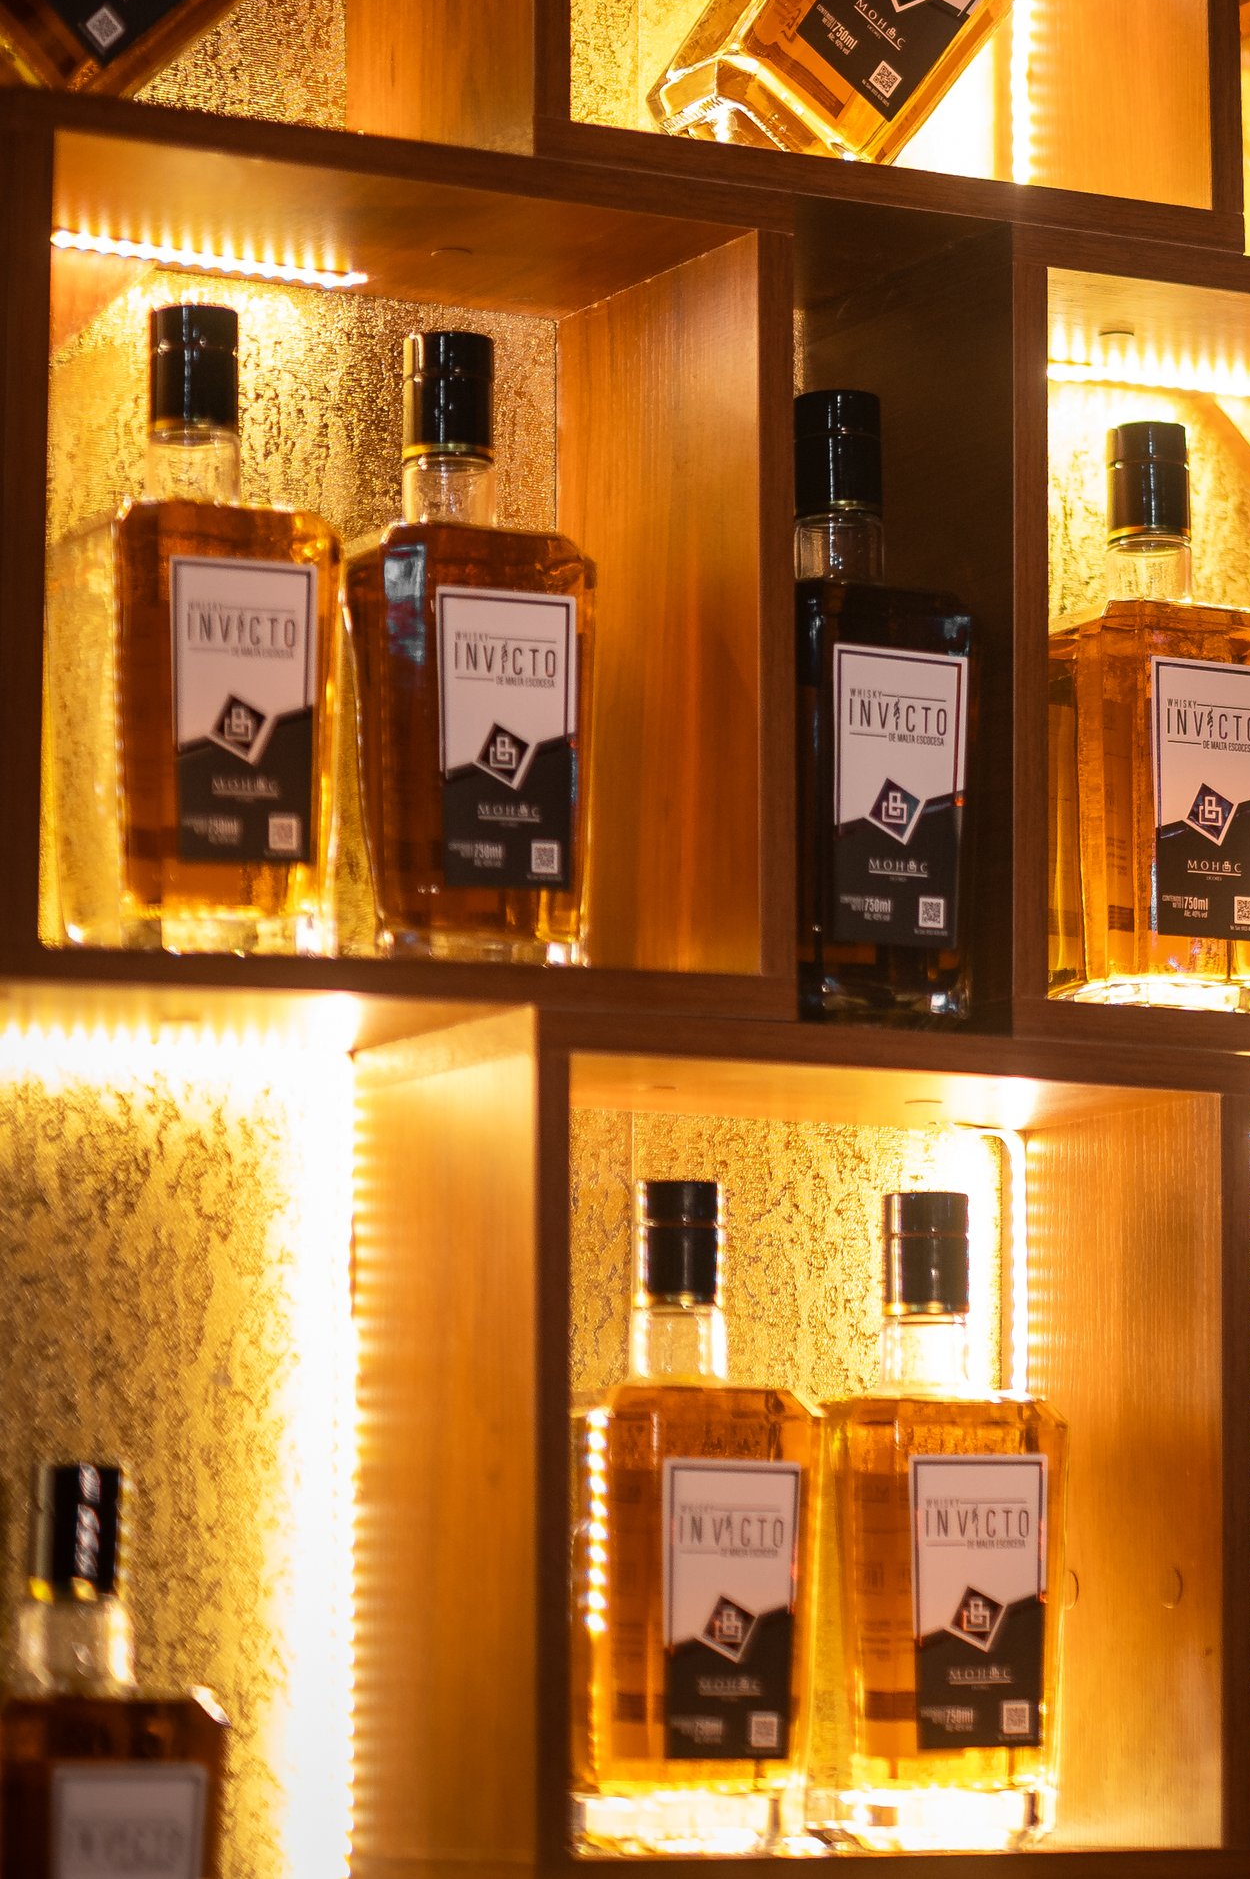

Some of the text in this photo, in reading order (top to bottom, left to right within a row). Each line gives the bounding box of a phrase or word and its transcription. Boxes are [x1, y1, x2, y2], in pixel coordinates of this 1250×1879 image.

[831, 21, 858, 50] 750ml
[187, 609, 296, 648] INVICTO
[454, 640, 557, 678] INVICTO
[849, 688, 883, 699] WHISKY
[1167, 698, 1197, 709] WHISKY
[849, 696, 948, 736] INVICTO
[888, 733, 945, 747] DE MALTA ESCOCESA
[1203, 740, 1211, 749] DE
[1211, 741, 1228, 750] MALTA
[864, 896, 892, 913] 750ml
[1184, 896, 1208, 911] 750ml
[679, 1511, 784, 1549] INVICTO
[925, 1505, 1029, 1538] INVICTO
